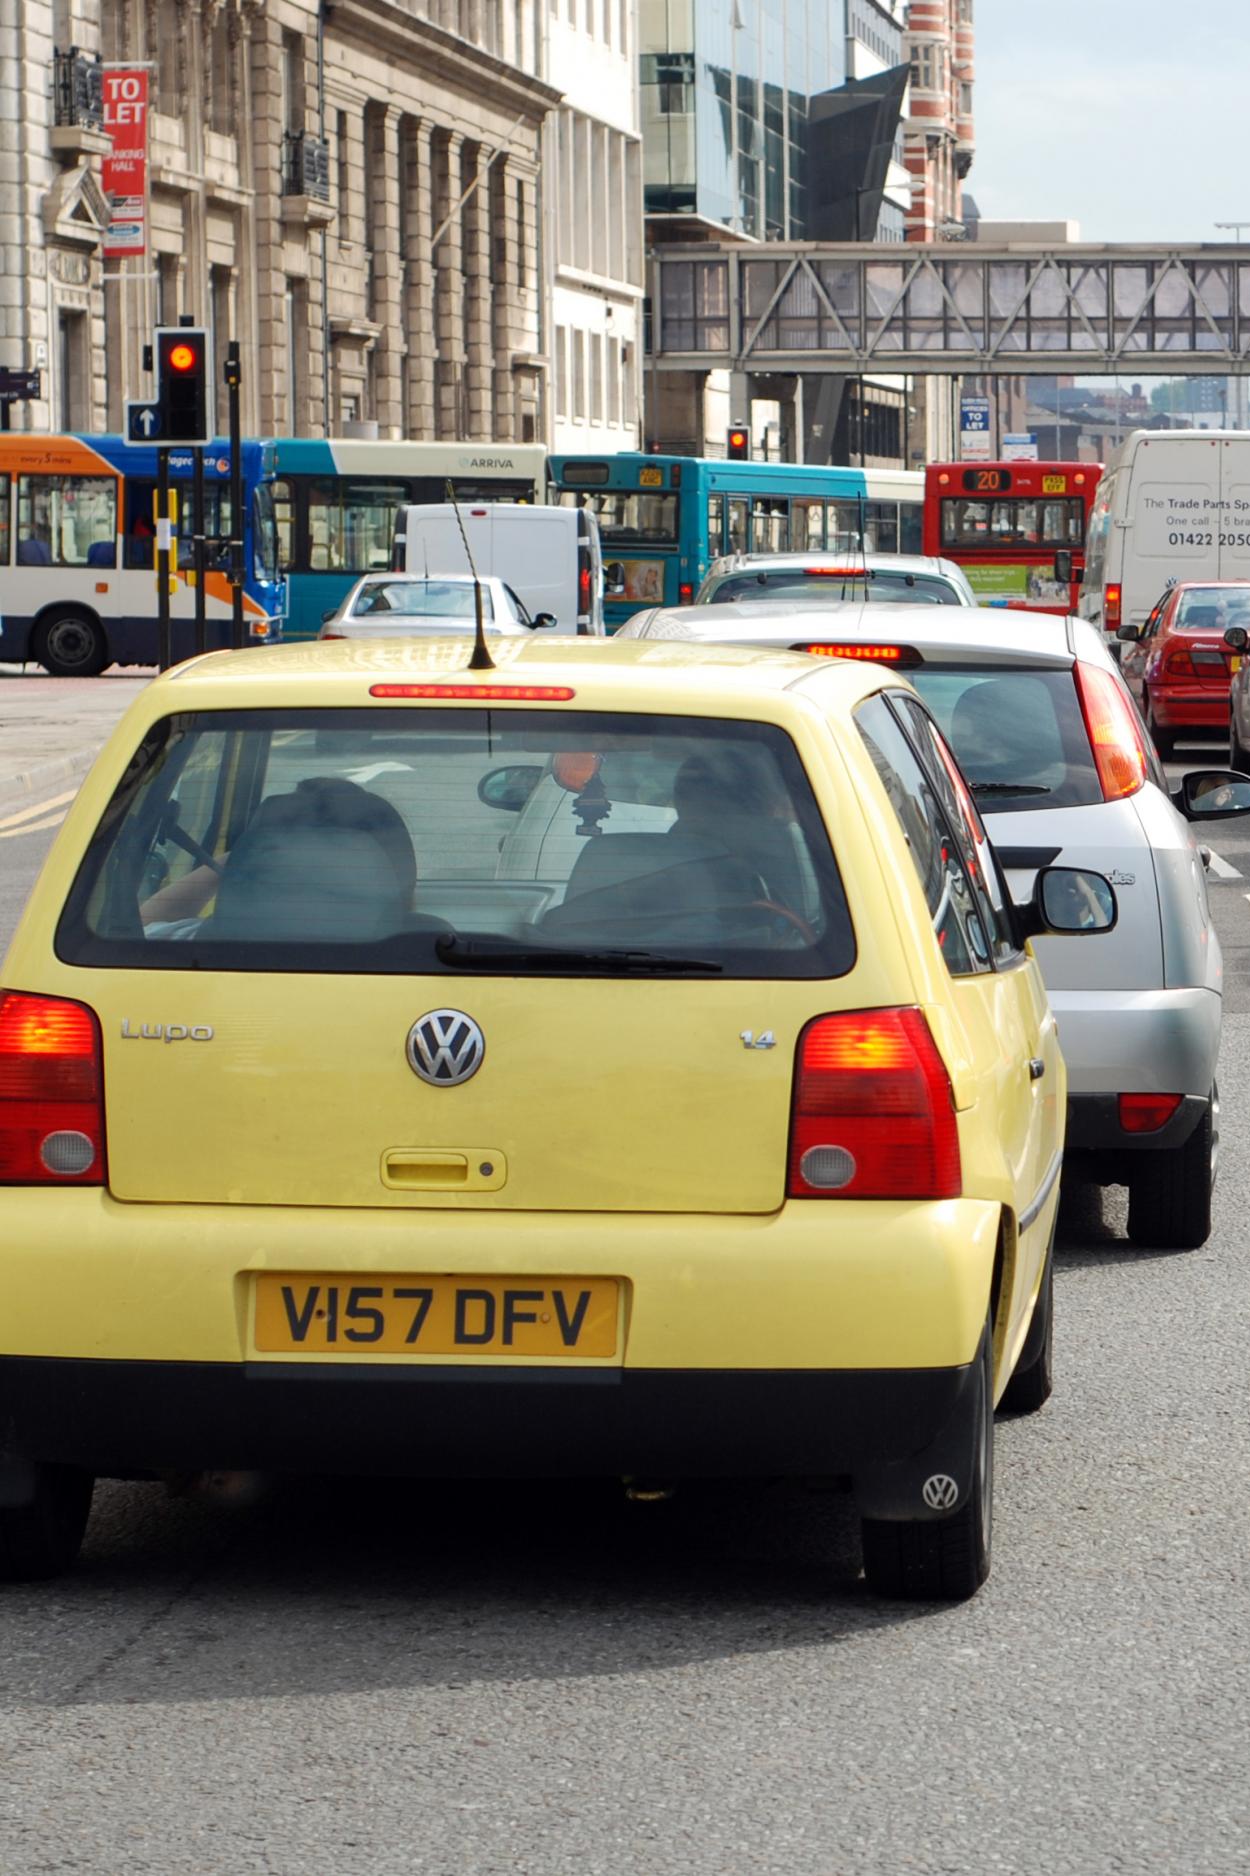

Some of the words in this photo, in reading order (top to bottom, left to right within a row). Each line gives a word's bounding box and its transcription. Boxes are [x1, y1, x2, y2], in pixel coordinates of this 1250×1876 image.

[107, 78, 140, 100] TO
[103, 102, 144, 124] LET
[111, 160, 135, 172] HALL
[968, 412, 982, 421] TO
[966, 422, 984, 430] LET
[470, 458, 514, 468] ARRIVA
[977, 471, 1000, 489] 20
[1144, 498, 1165, 509] The
[1168, 499, 1200, 509] Trade
[1203, 499, 1231, 509] Parts
[1166, 515, 1188, 526] One
[1191, 515, 1210, 526] call
[1224, 516, 1231, 526] 5
[1168, 533, 1213, 546] 01422
[120, 1016, 214, 1044] Lupo
[280, 1286, 434, 1344] V157
[453, 1288, 593, 1347] DFV
